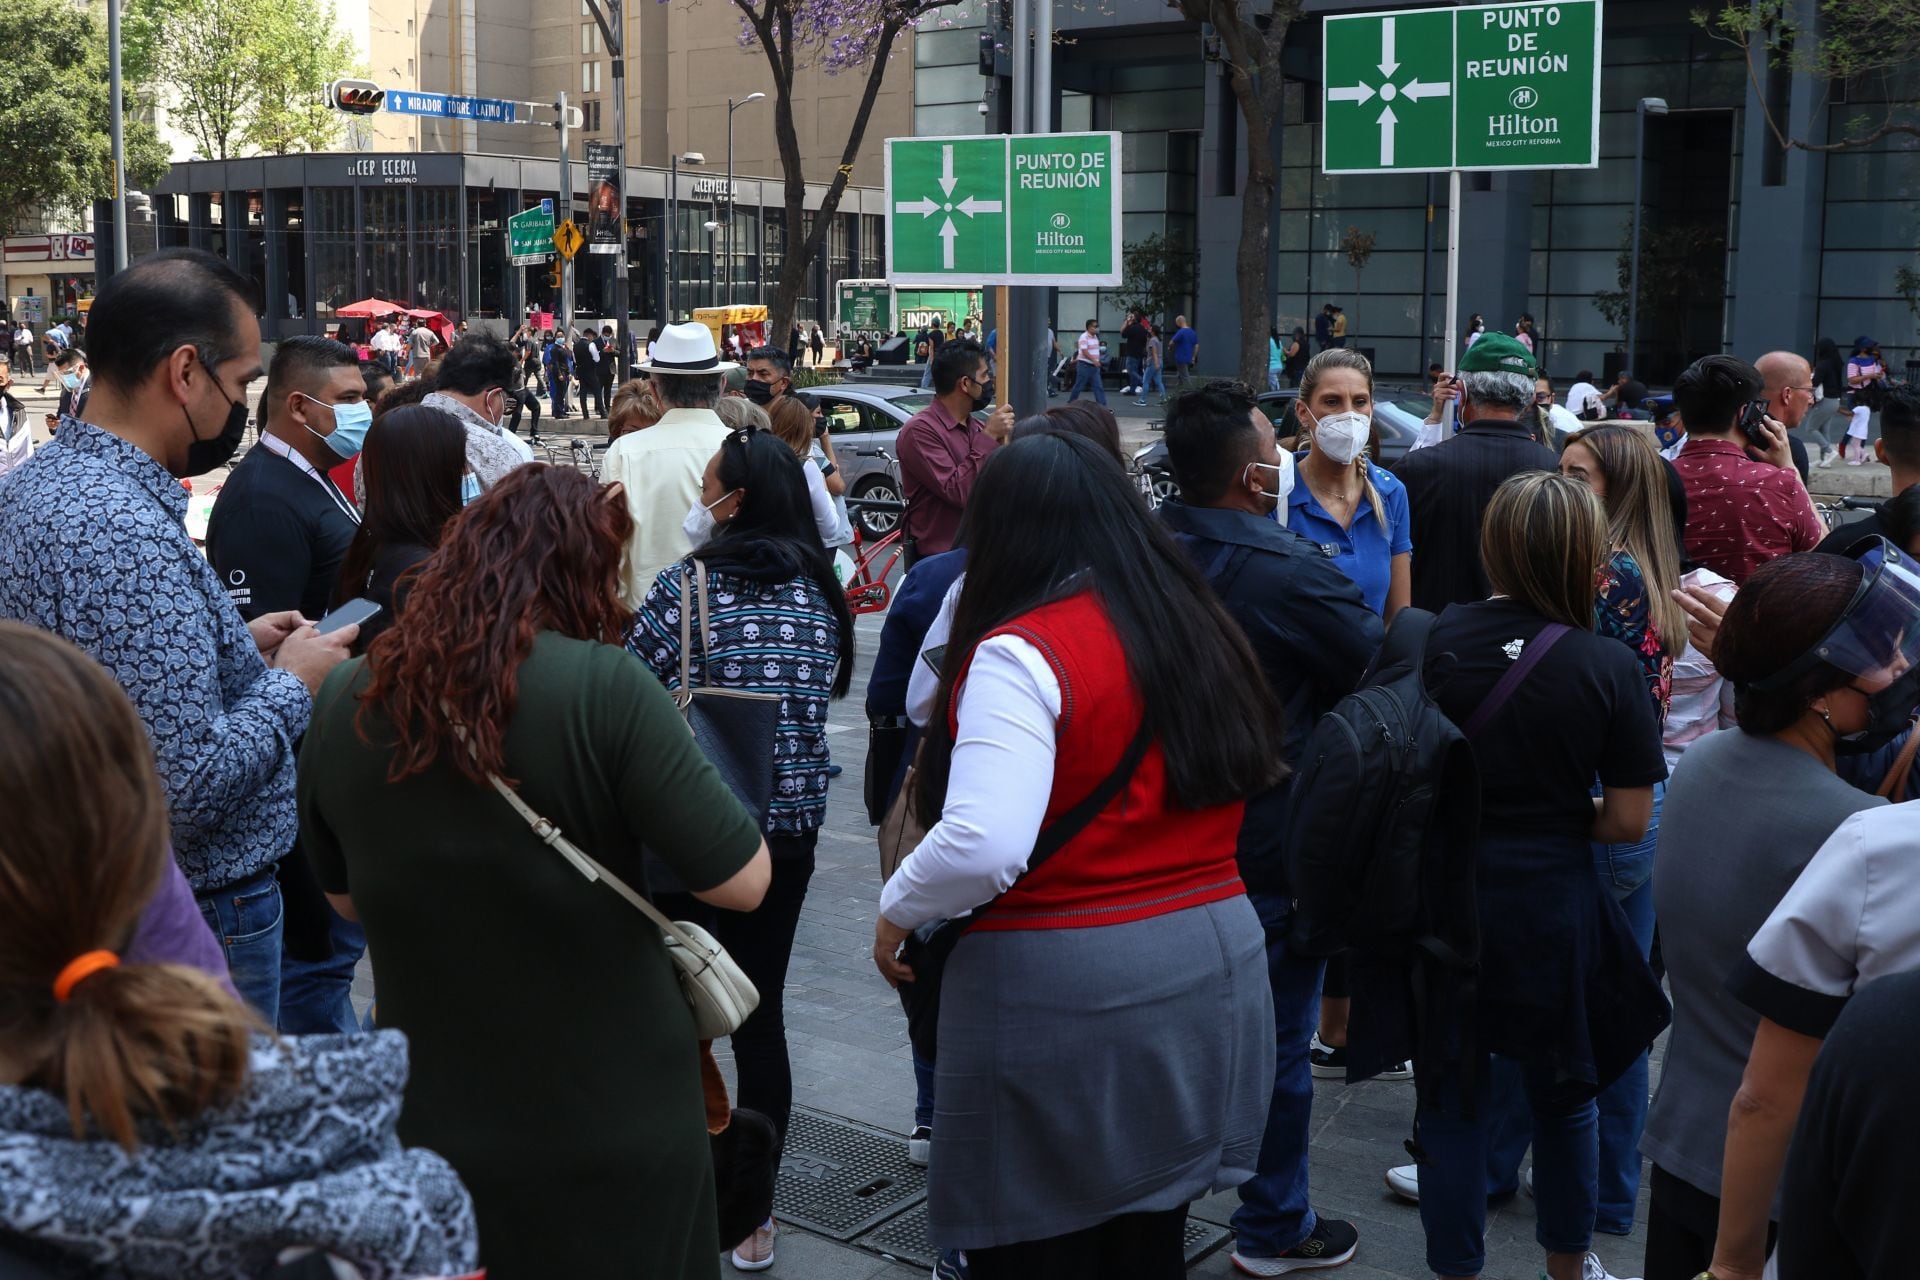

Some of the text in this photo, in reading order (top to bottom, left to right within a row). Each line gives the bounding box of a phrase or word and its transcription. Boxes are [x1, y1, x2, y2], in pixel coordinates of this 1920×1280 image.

[1483, 6, 1561, 30] PUNTO
[1508, 32, 1538, 52] DE
[1466, 51, 1568, 79] REUNIÓN
[407, 95, 501, 118] MIRADOR TORRE LATINO
[1488, 113, 1558, 136] Hilton
[1528, 137, 1561, 145] REFORMA
[1015, 152, 1105, 170] PUNTO DE
[700, 178, 738, 195] CERVECEIA
[1020, 168, 1100, 189] REUNIÓN
[1037, 231, 1084, 246] Hilton
[906, 311, 942, 328] INDIO
